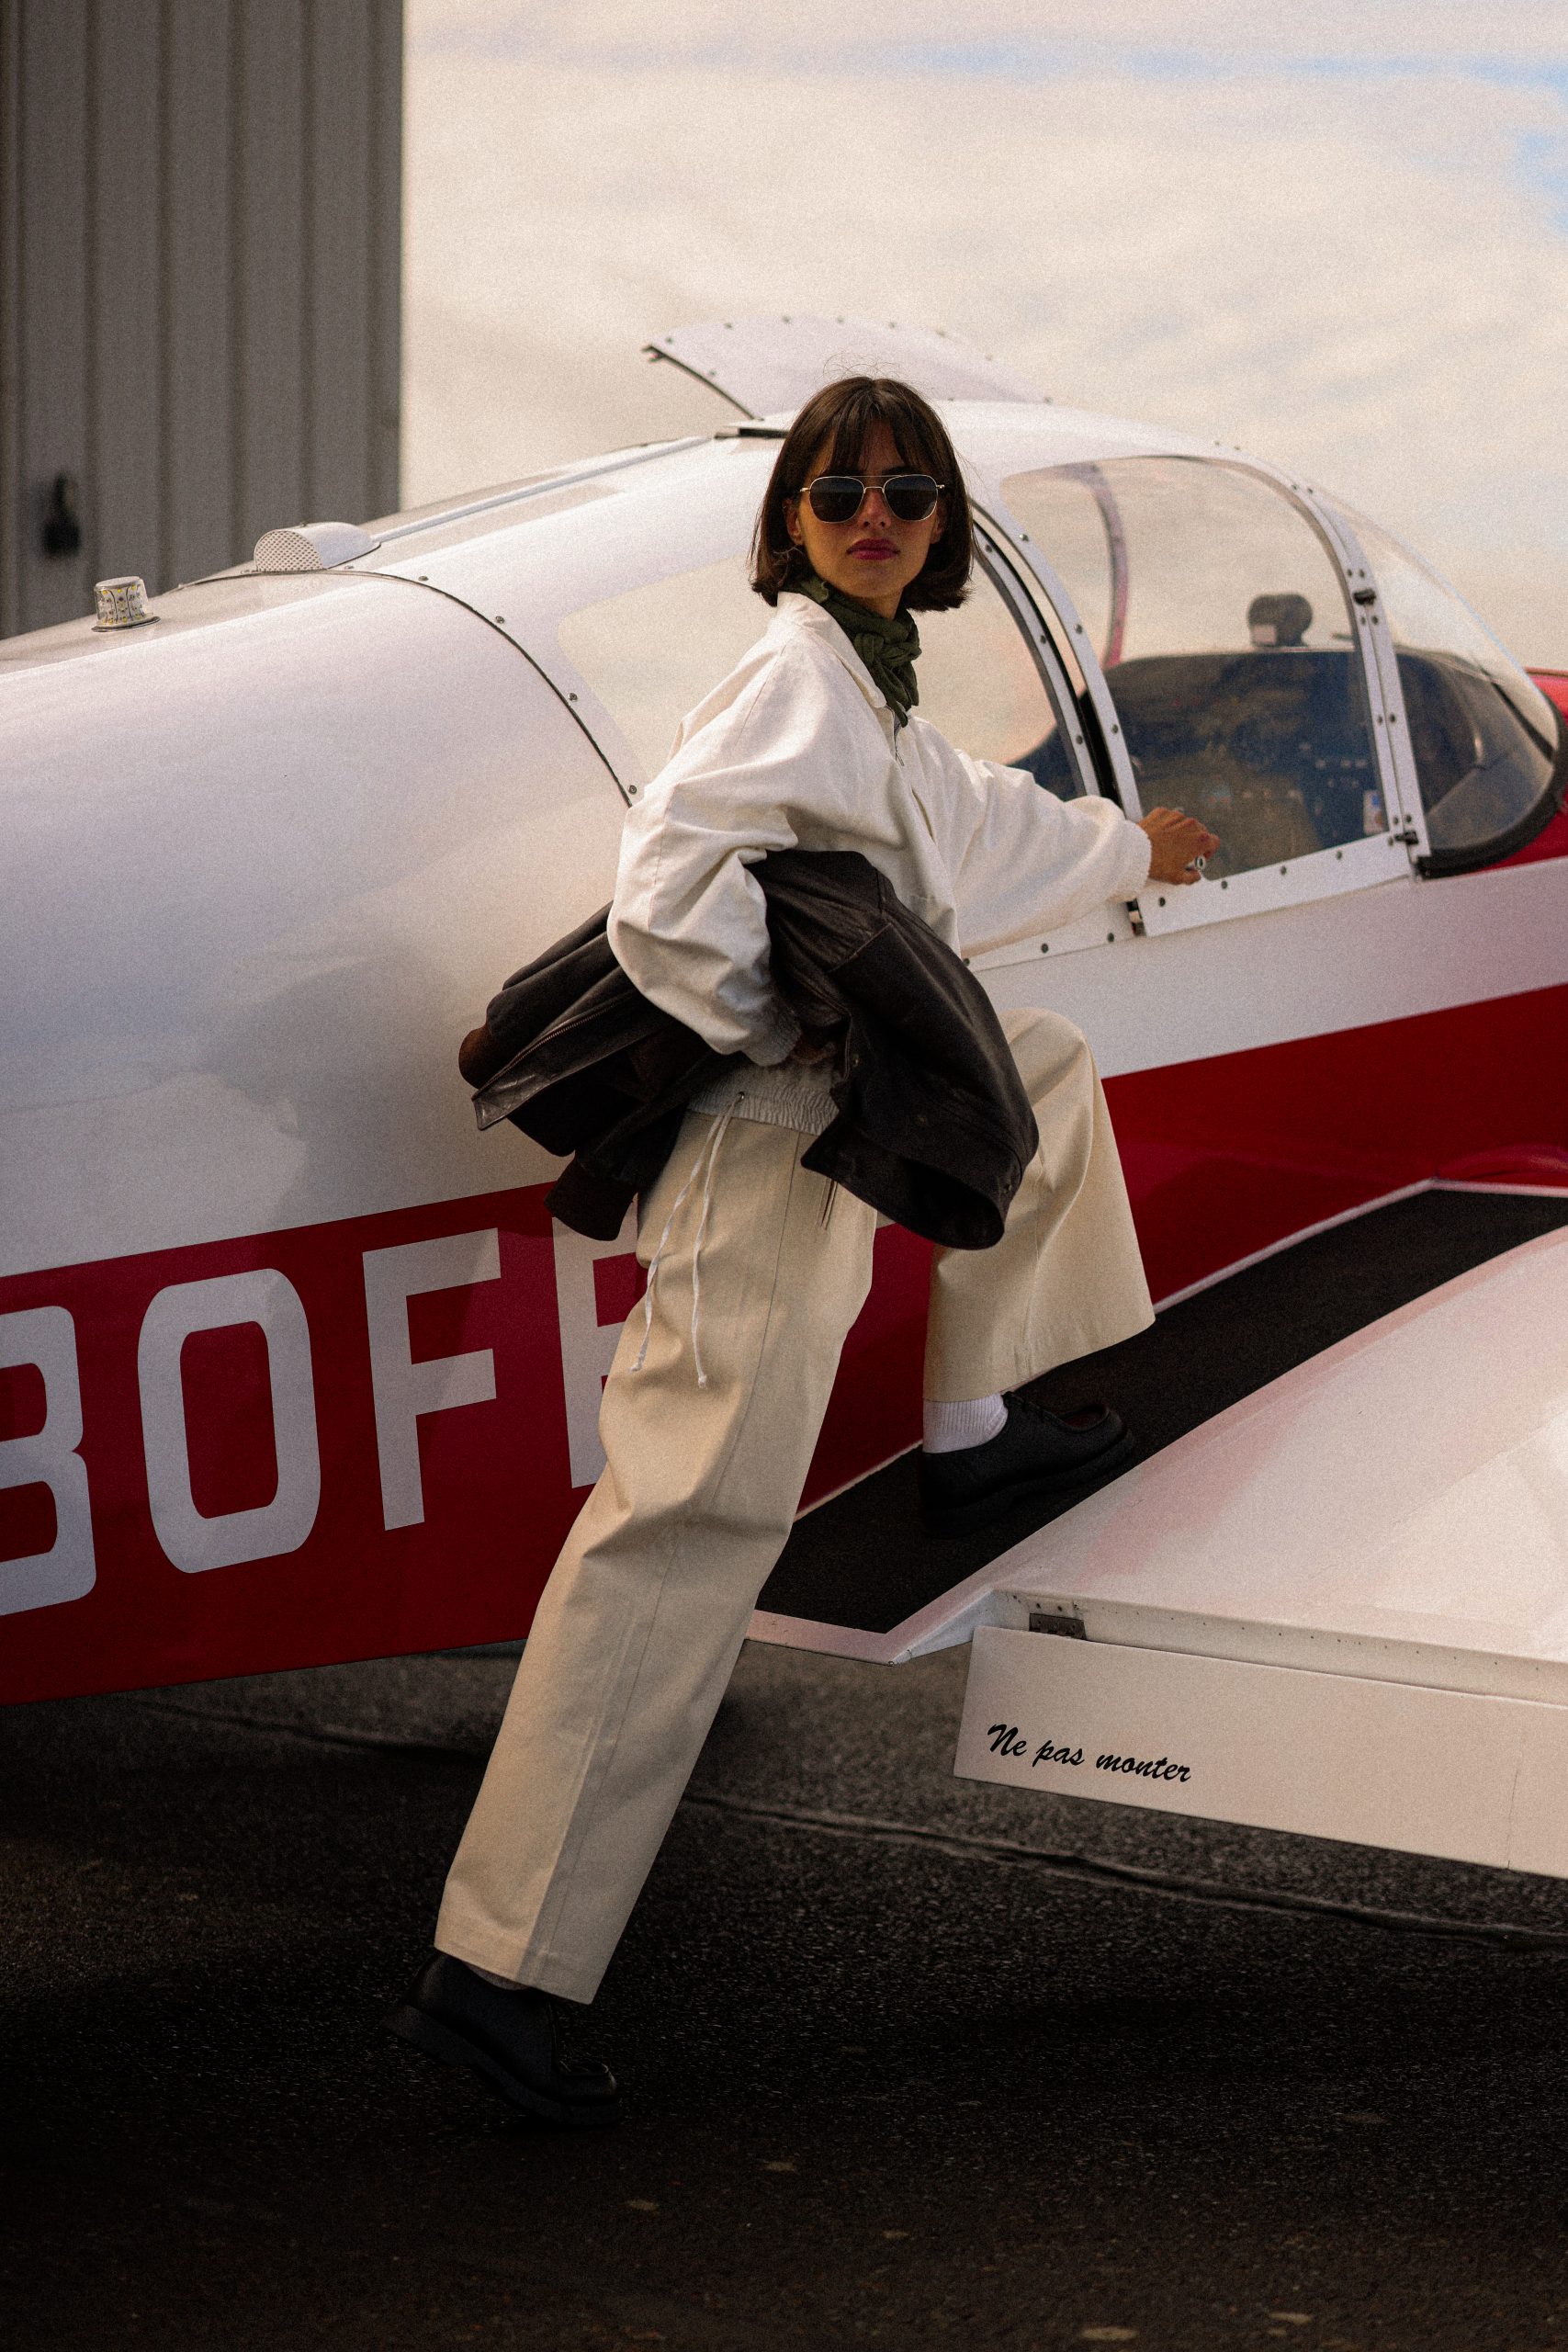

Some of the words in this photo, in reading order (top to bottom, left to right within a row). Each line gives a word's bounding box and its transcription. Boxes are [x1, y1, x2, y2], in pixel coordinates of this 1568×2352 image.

[987, 1724, 1027, 1757] Ne
[1032, 1739, 1085, 1767] pas
[1096, 1754, 1191, 1782] monter
